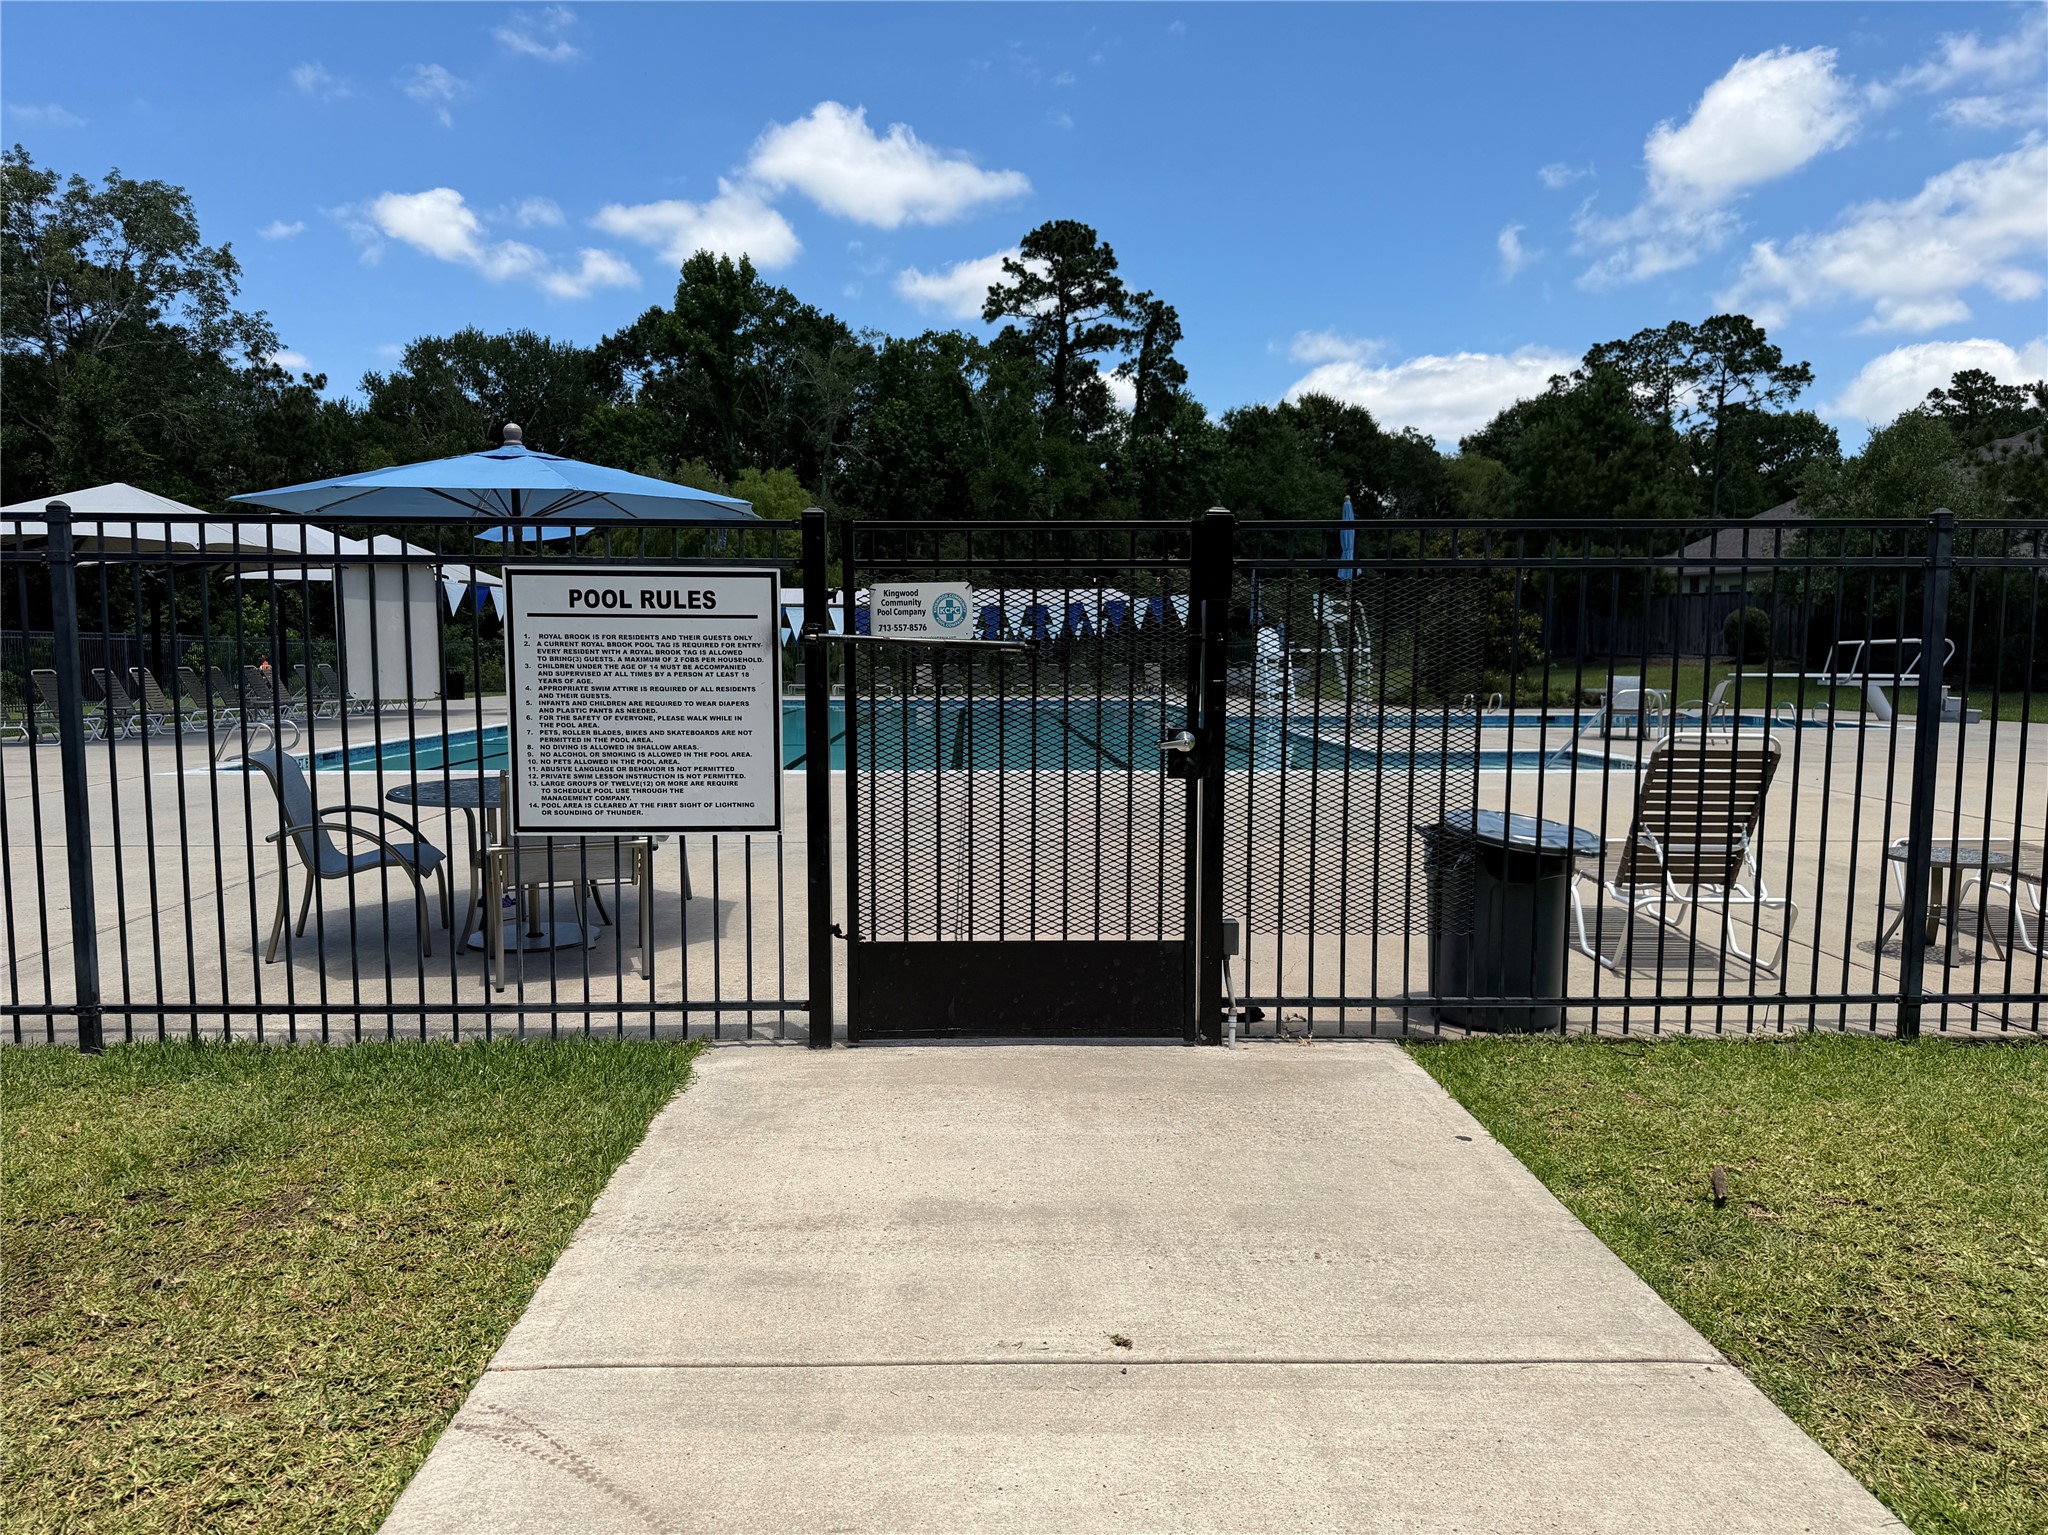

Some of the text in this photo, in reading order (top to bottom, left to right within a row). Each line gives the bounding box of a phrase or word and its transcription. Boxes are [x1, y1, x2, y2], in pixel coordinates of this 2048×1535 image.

[884, 589, 918, 598] Kingwood
[569, 589, 716, 609] POOL RULES
[881, 598, 922, 608] Community
[894, 608, 926, 617] Company
[878, 624, 927, 632] 713-557-8576
